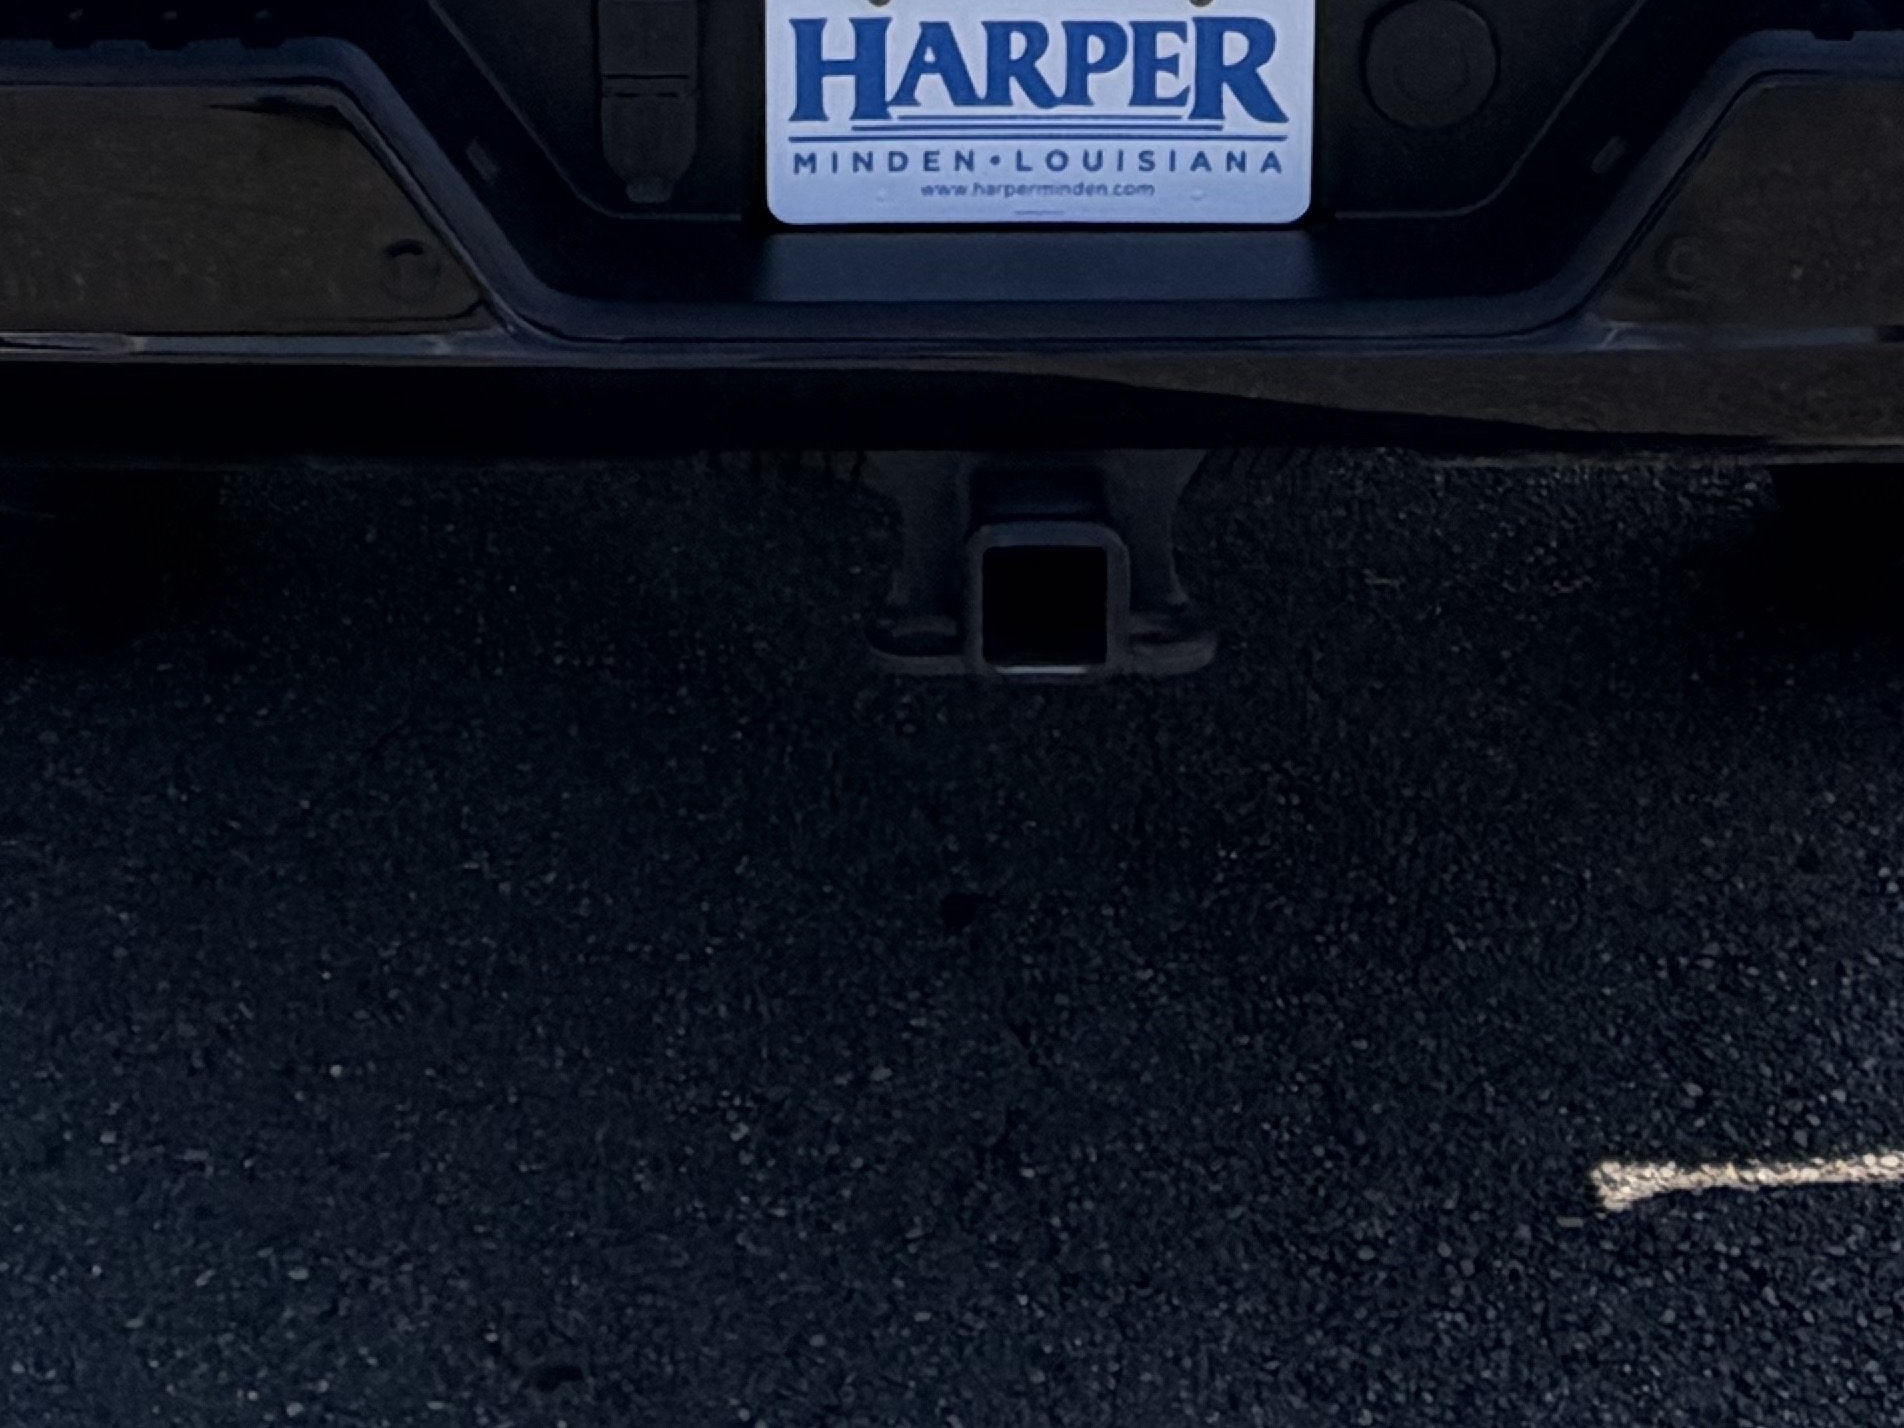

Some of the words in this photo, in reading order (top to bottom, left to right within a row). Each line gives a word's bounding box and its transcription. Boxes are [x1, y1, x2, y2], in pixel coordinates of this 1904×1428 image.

[788, 15, 1290, 124] HARPER
[793, 149, 976, 174] MINDEN
[1015, 149, 1283, 174] LOUISIANA
[920, 181, 1156, 199] www.harperminden.com
